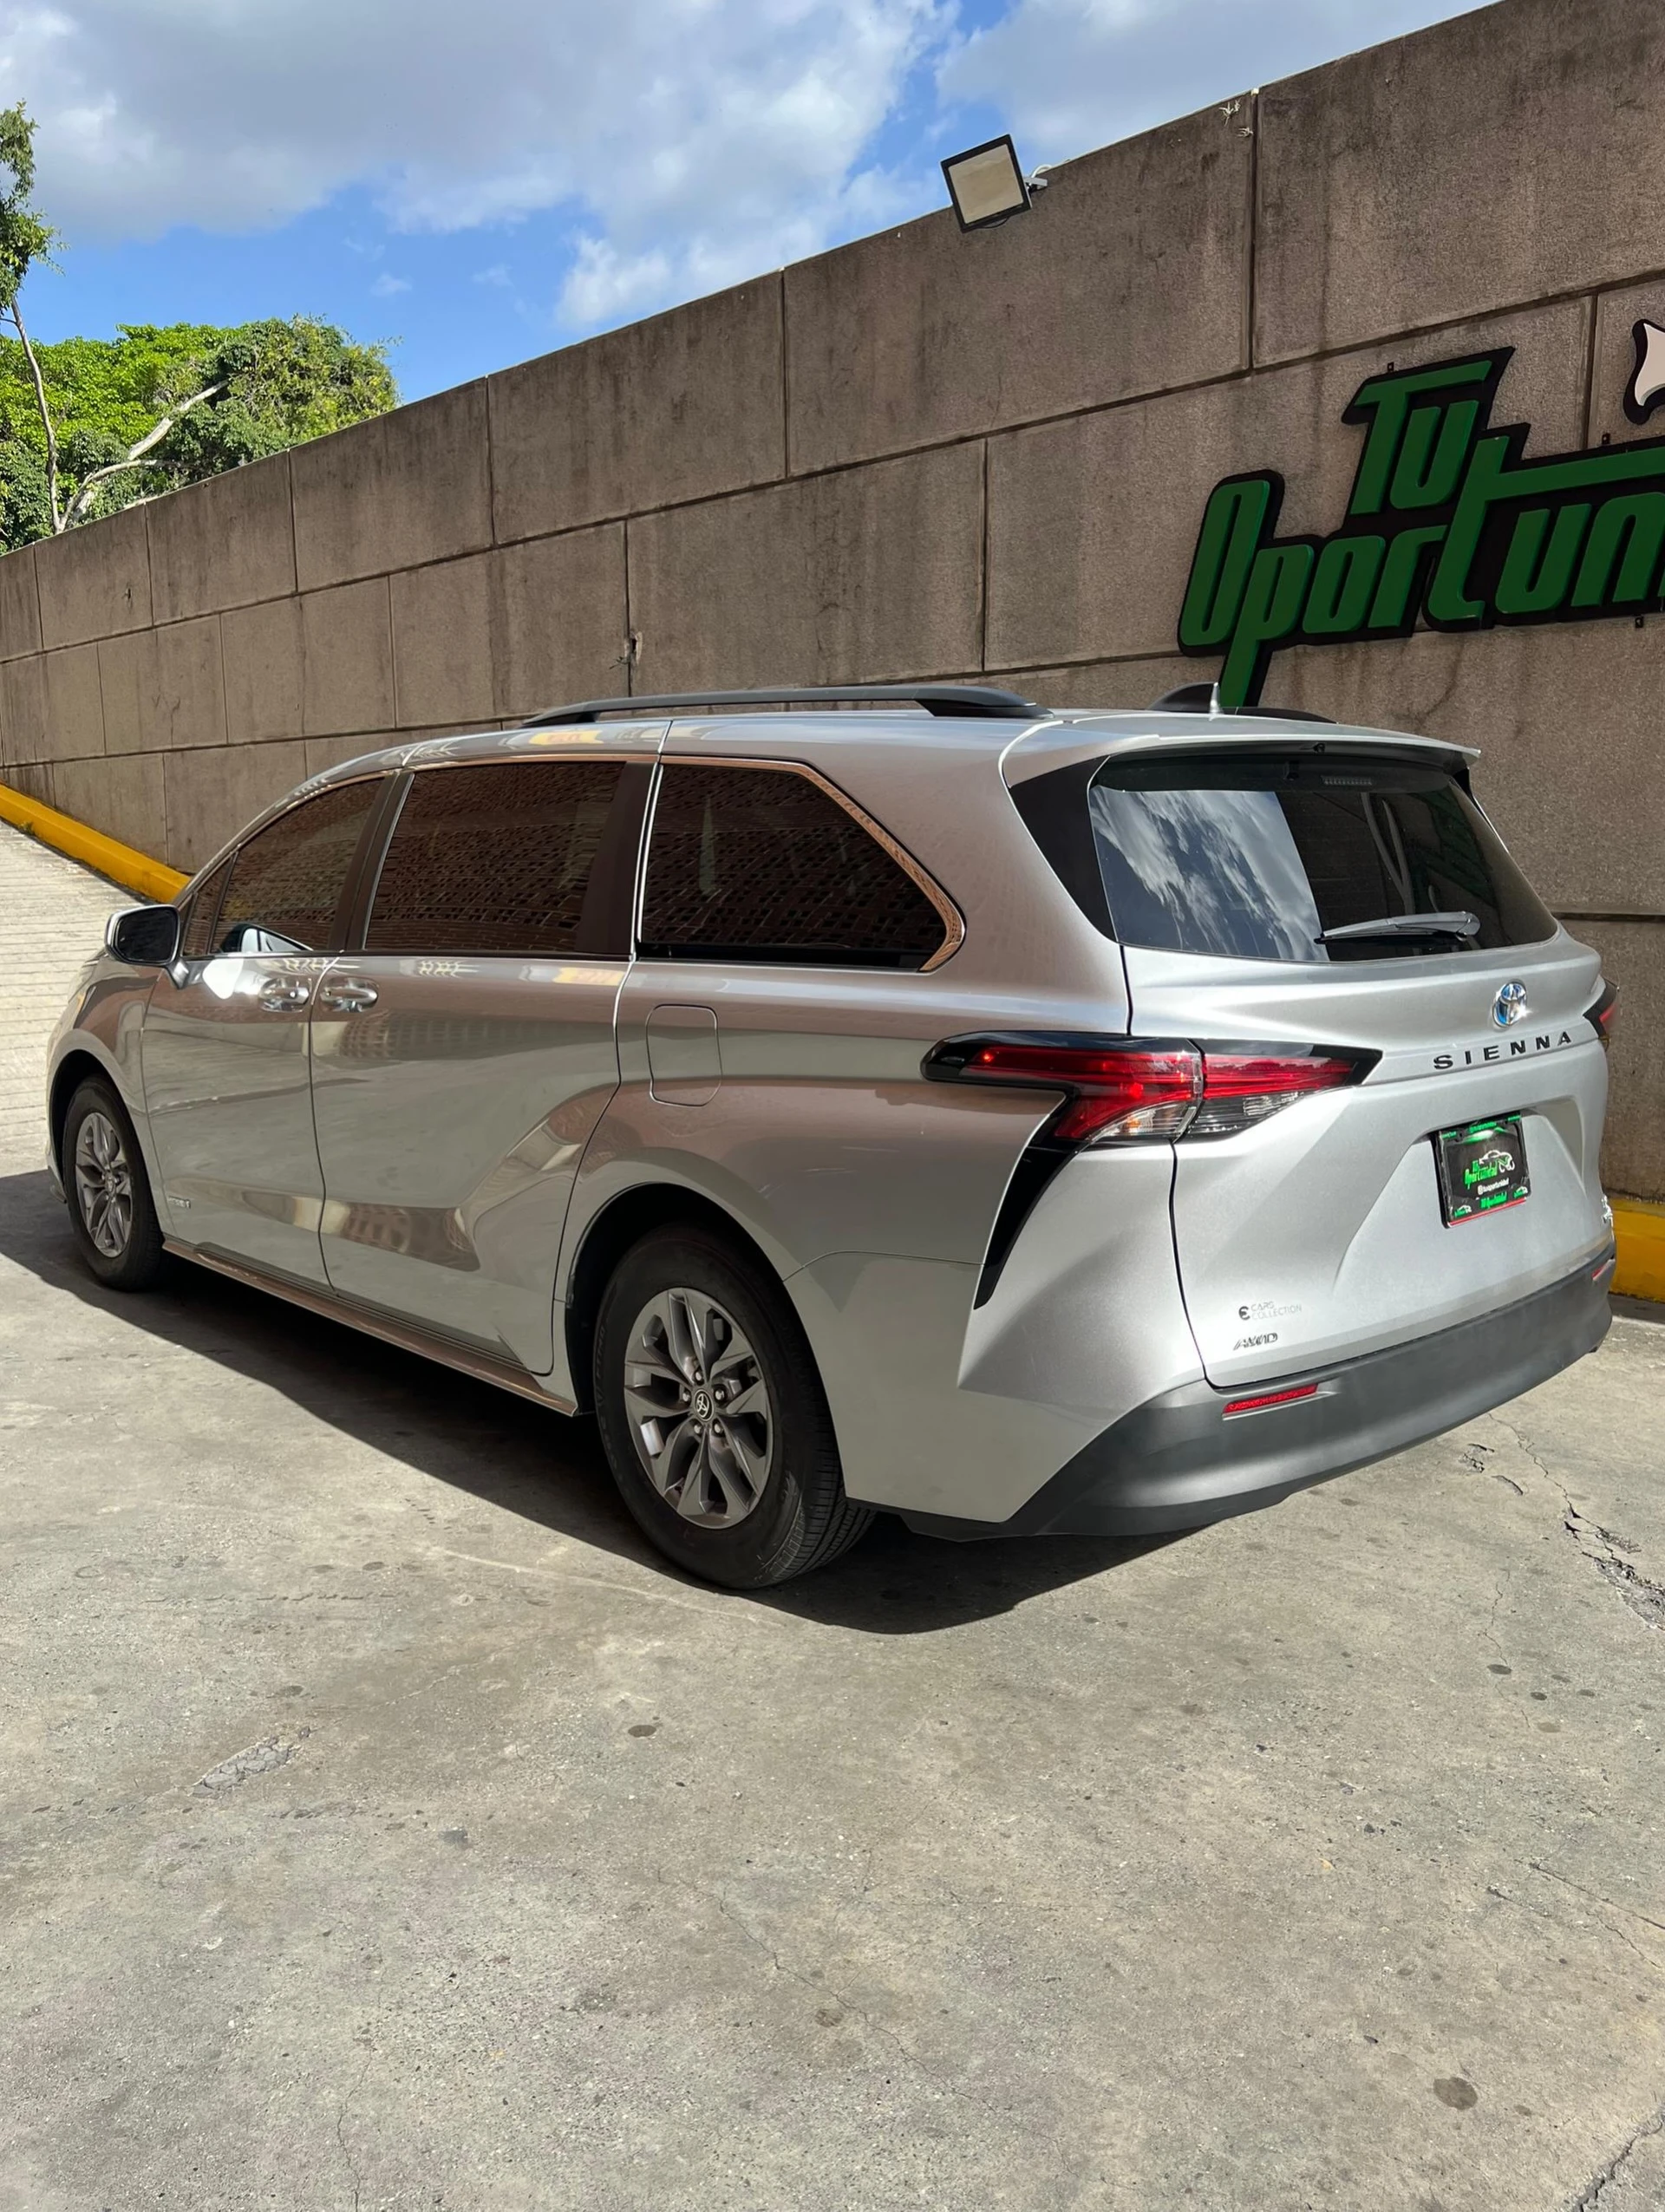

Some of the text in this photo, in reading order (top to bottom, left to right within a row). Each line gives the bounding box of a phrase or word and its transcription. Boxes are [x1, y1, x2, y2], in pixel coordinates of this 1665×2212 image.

[1179, 434, 1665, 708] Oportun
[1433, 1031, 1571, 1070] SIENNA
[1250, 1301, 1275, 1312] CARS
[1250, 1303, 1303, 1321] COLLECTION
[1233, 1332, 1278, 1351] AWD
